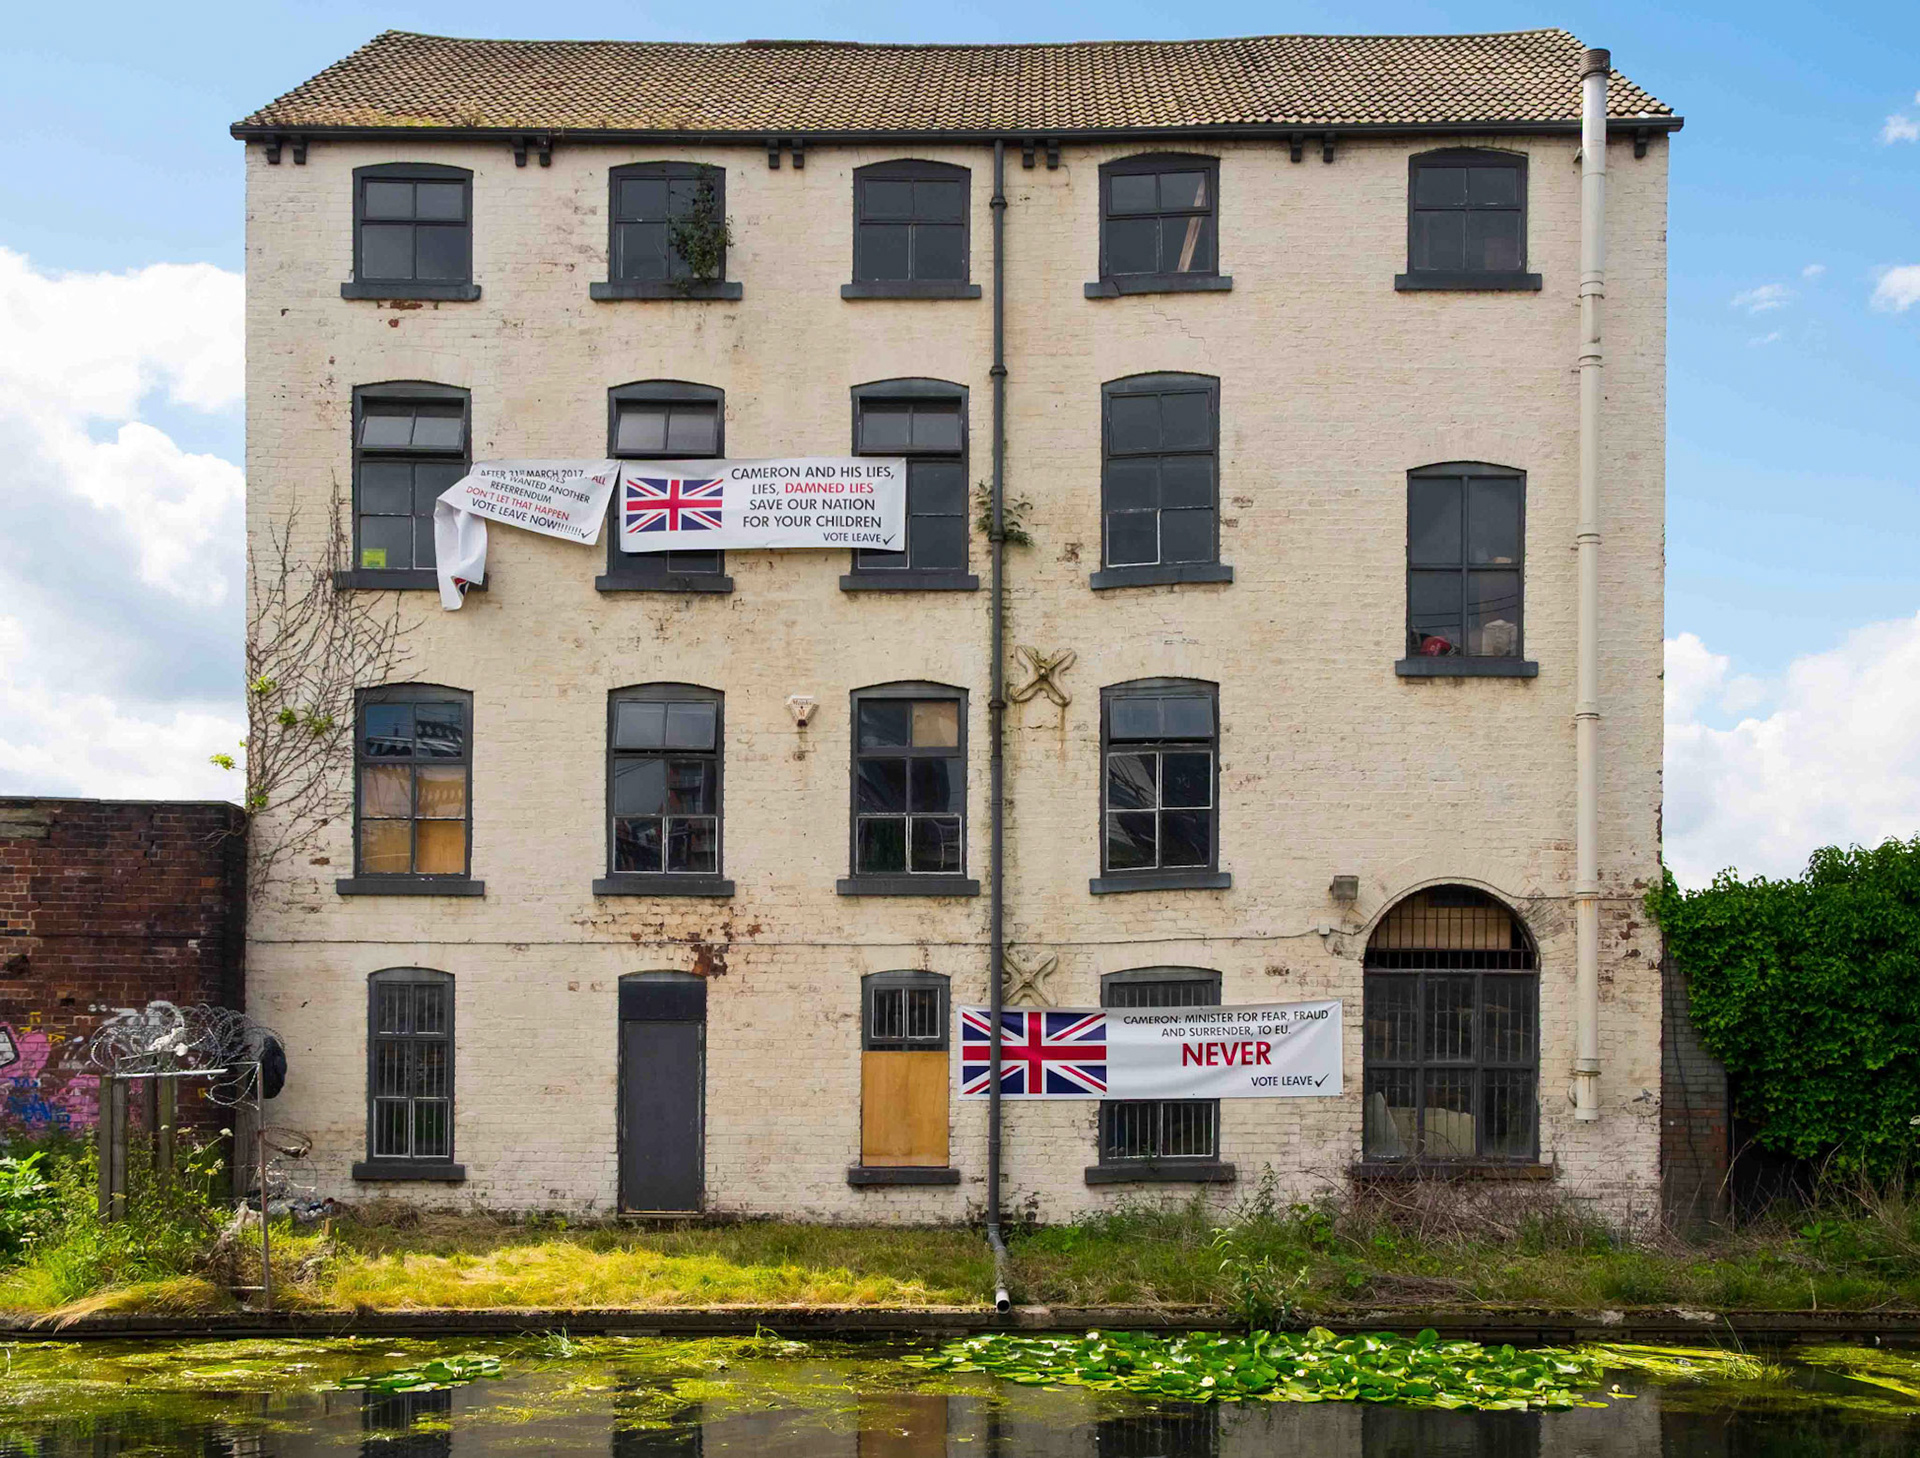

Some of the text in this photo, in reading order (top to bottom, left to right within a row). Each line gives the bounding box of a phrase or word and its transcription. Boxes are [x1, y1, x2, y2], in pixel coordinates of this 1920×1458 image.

[526, 470, 558, 478] MARCH
[731, 466, 894, 480] CAMERON AND HIS LIES,
[490, 480, 552, 504] REFERRENDUM
[548, 485, 590, 503] ANOTHER
[752, 482, 874, 496] LIES, DAMNED LIES
[472, 497, 497, 512] VOTE
[498, 506, 528, 522] LEAVE
[496, 494, 510, 504] LET
[512, 498, 532, 510] THAT
[534, 504, 570, 521] HAPPEN
[750, 498, 875, 510] SAVE OUR NATION
[743, 516, 882, 528] FOR YOUR CHILDREN
[823, 532, 882, 542] VOTE LEAVE
[1123, 1010, 1328, 1024] CAMERON: MINISTER FOR FEAR, FRAUD
[1162, 1025, 1291, 1037] AND SURRENDER, TO EU.
[1182, 1041, 1272, 1067] NEVER
[1251, 1076, 1313, 1086] VOTE LEAVE
